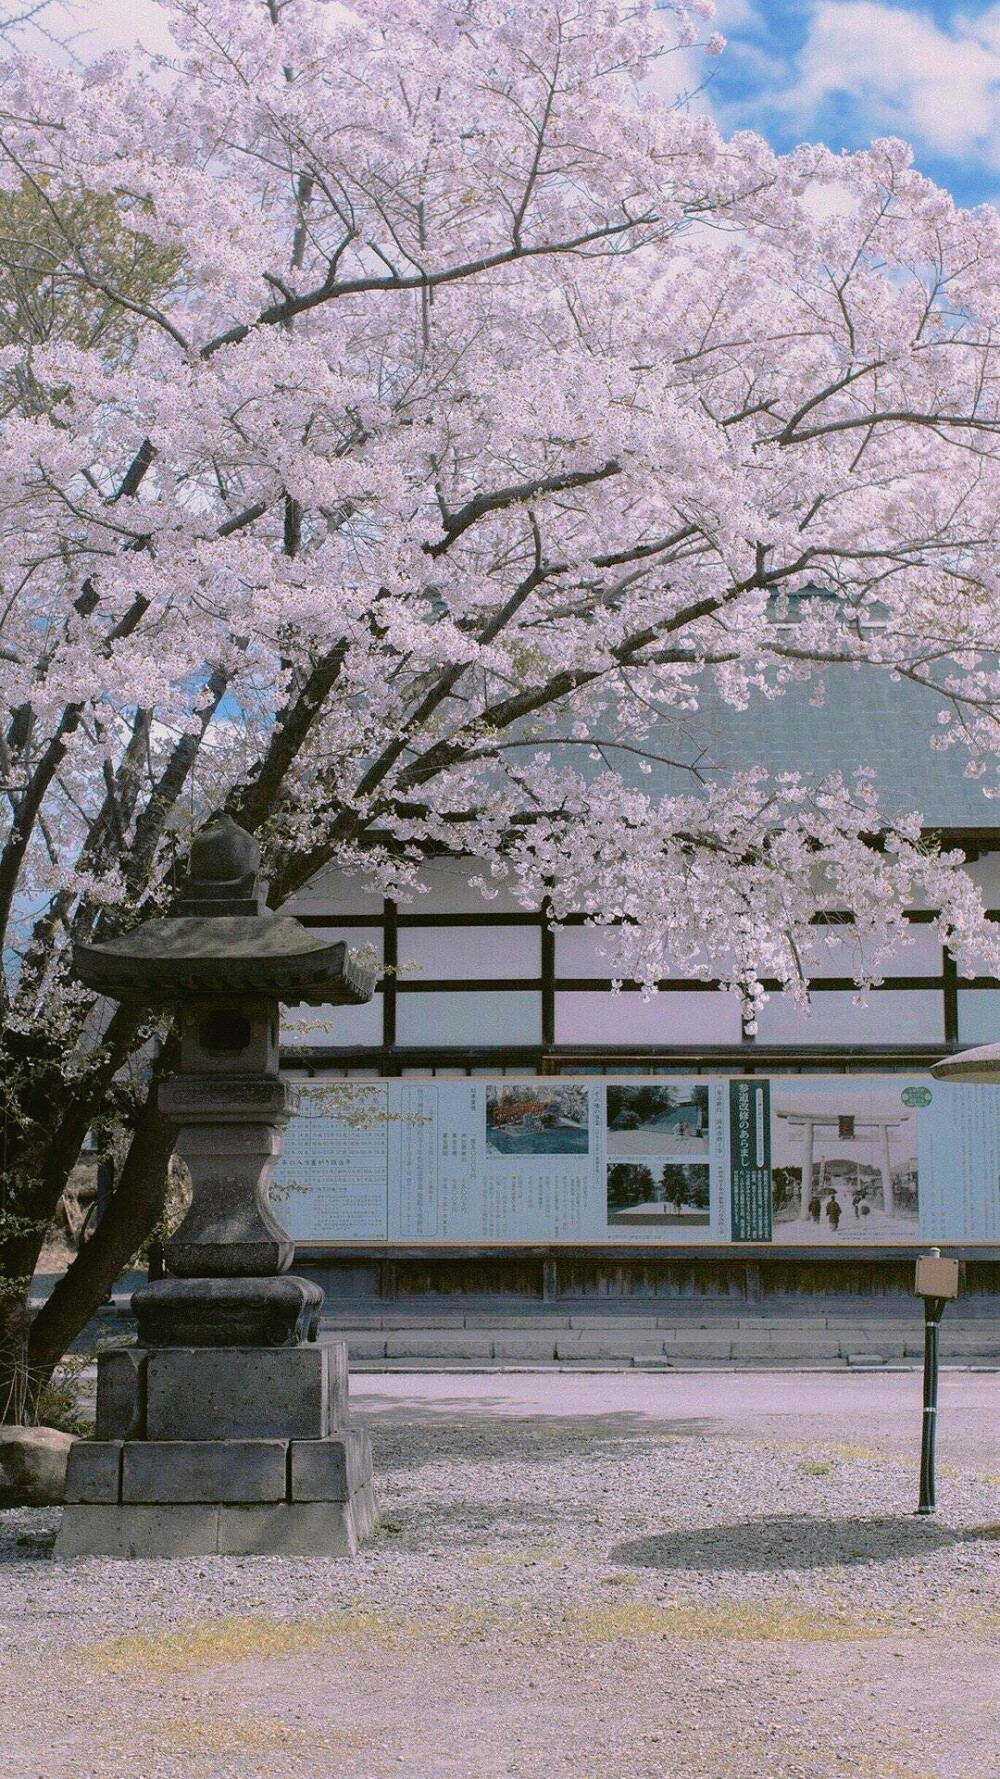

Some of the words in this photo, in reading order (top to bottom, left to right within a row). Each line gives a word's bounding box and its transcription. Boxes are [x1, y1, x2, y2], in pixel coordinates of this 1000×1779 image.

[738, 1083, 750, 1167] 参道改修のあらまし
